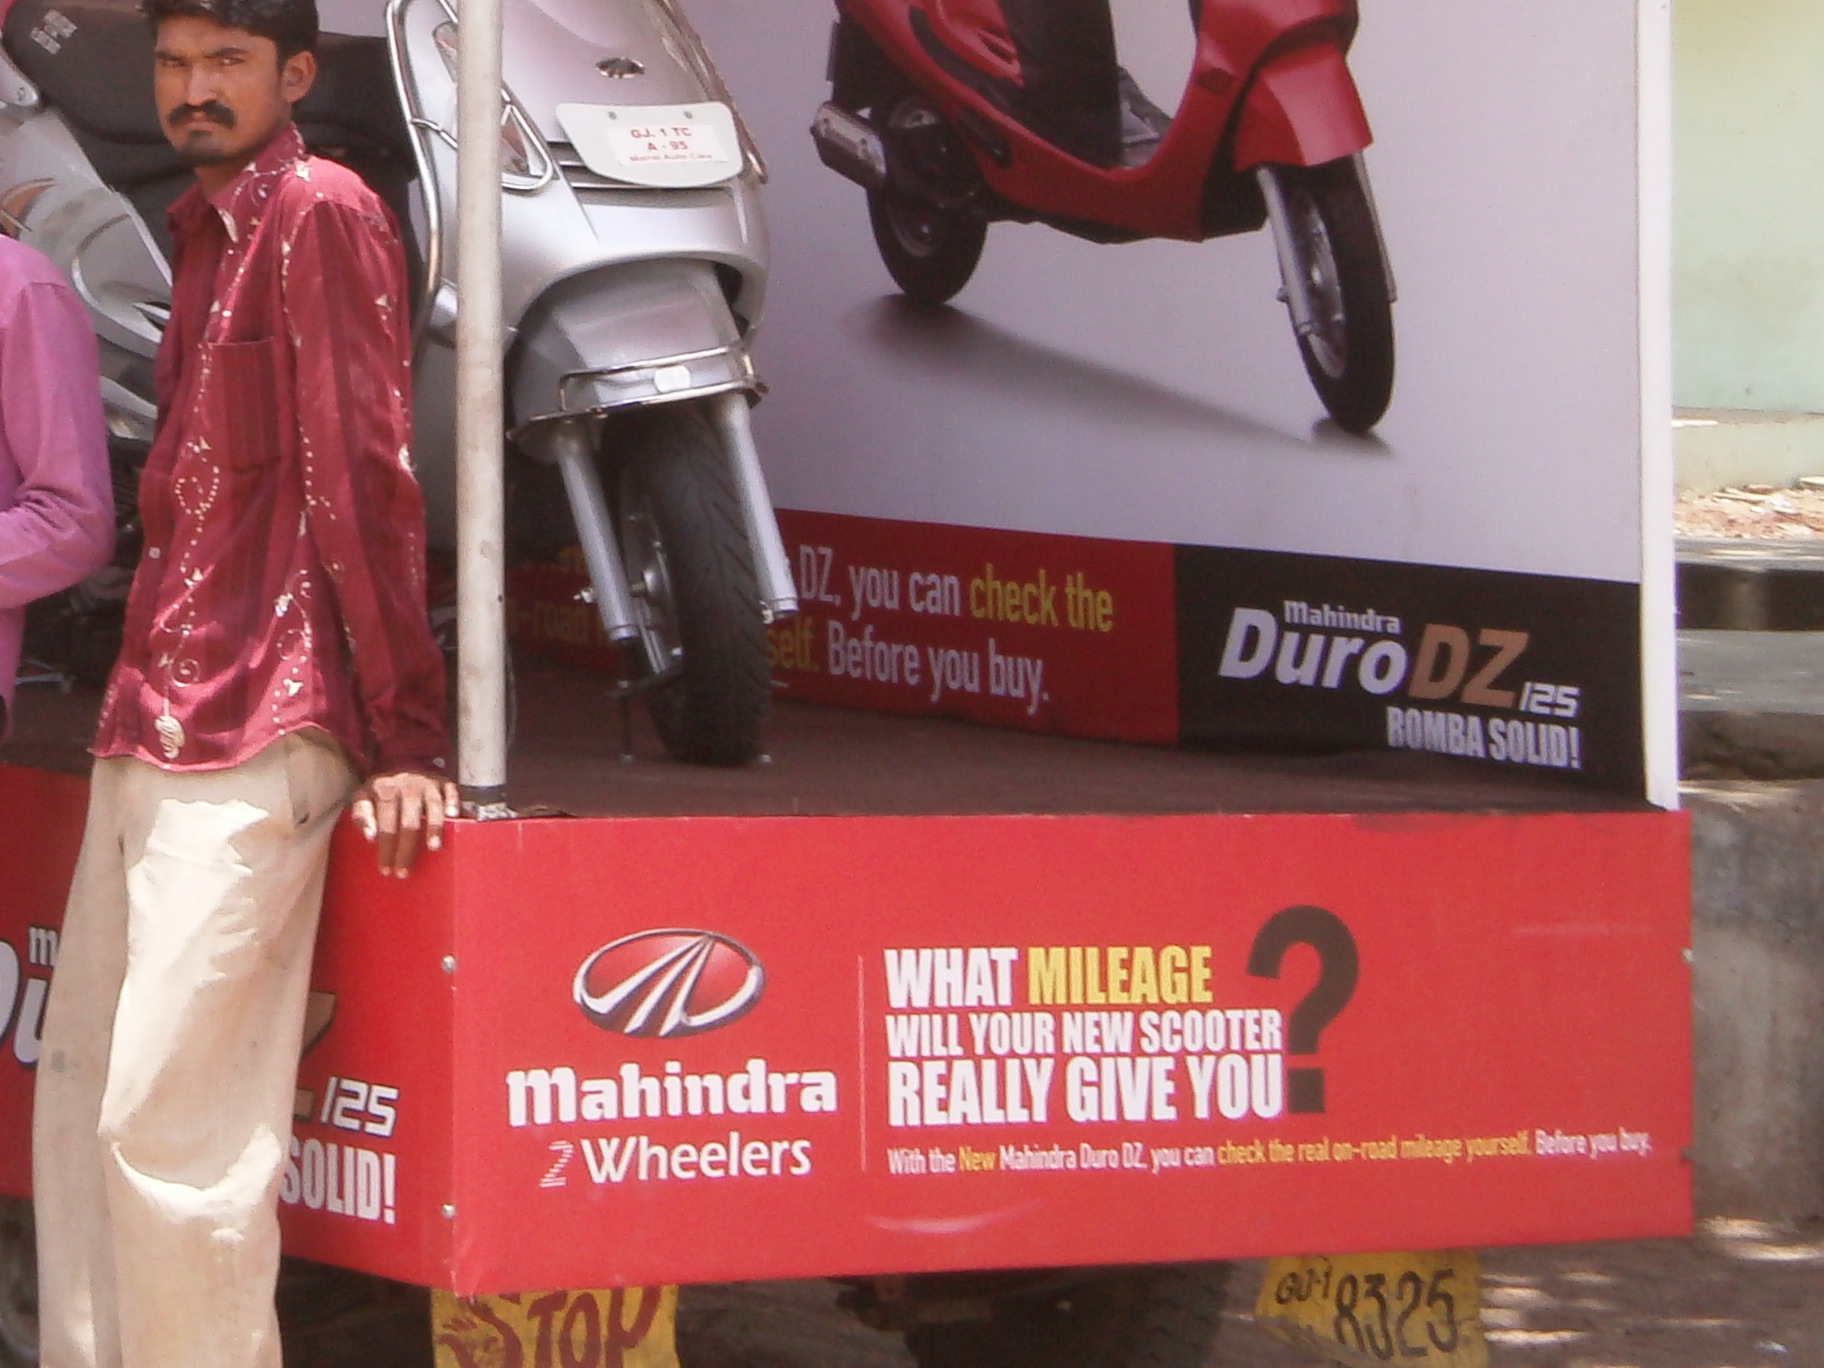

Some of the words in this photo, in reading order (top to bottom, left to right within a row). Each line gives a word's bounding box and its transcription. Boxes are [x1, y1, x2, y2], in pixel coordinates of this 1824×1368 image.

[849, 565, 899, 621] you
[909, 572, 961, 616] can
[970, 563, 1059, 627] check
[1065, 571, 1114, 632] the
[828, 620, 920, 686] Before
[928, 647, 980, 702] you
[988, 638, 1050, 717] buy.
[1386, 706, 1486, 759] ROMBA
[1489, 718, 1581, 769] SOLID!
[884, 947, 1018, 1009] WHAT
[1027, 946, 1213, 1004] MILEAGE
[885, 1014, 964, 1057] WILL
[969, 1013, 1055, 1055] YOUR
[1062, 1011, 1134, 1053] NEW
[1139, 1009, 1282, 1051] SCOOTER
[320, 1076, 399, 1137] 125
[887, 1058, 1054, 1127] REALLY
[1066, 1057, 1177, 1122] GIVE
[1182, 1054, 1283, 1120] YOU
[280, 1135, 397, 1225] SOLID!
[581, 1131, 812, 1184] Wheelers
[887, 1147, 926, 1175] With
[929, 1147, 955, 1173] the
[959, 1146, 996, 1171] New
[999, 1143, 1076, 1170] Mahindra
[1079, 1142, 1119, 1169] Duro
[1150, 1146, 1181, 1175] you
[1184, 1145, 1215, 1167] can
[1217, 1139, 1266, 1166] check
[1269, 1139, 1294, 1164] the
[1298, 1137, 1330, 1162] real
[1333, 1134, 1397, 1162] on-road
[1401, 1132, 1462, 1165] mileage
[1535, 1127, 1587, 1156] Before
[1589, 1131, 1616, 1160] you
